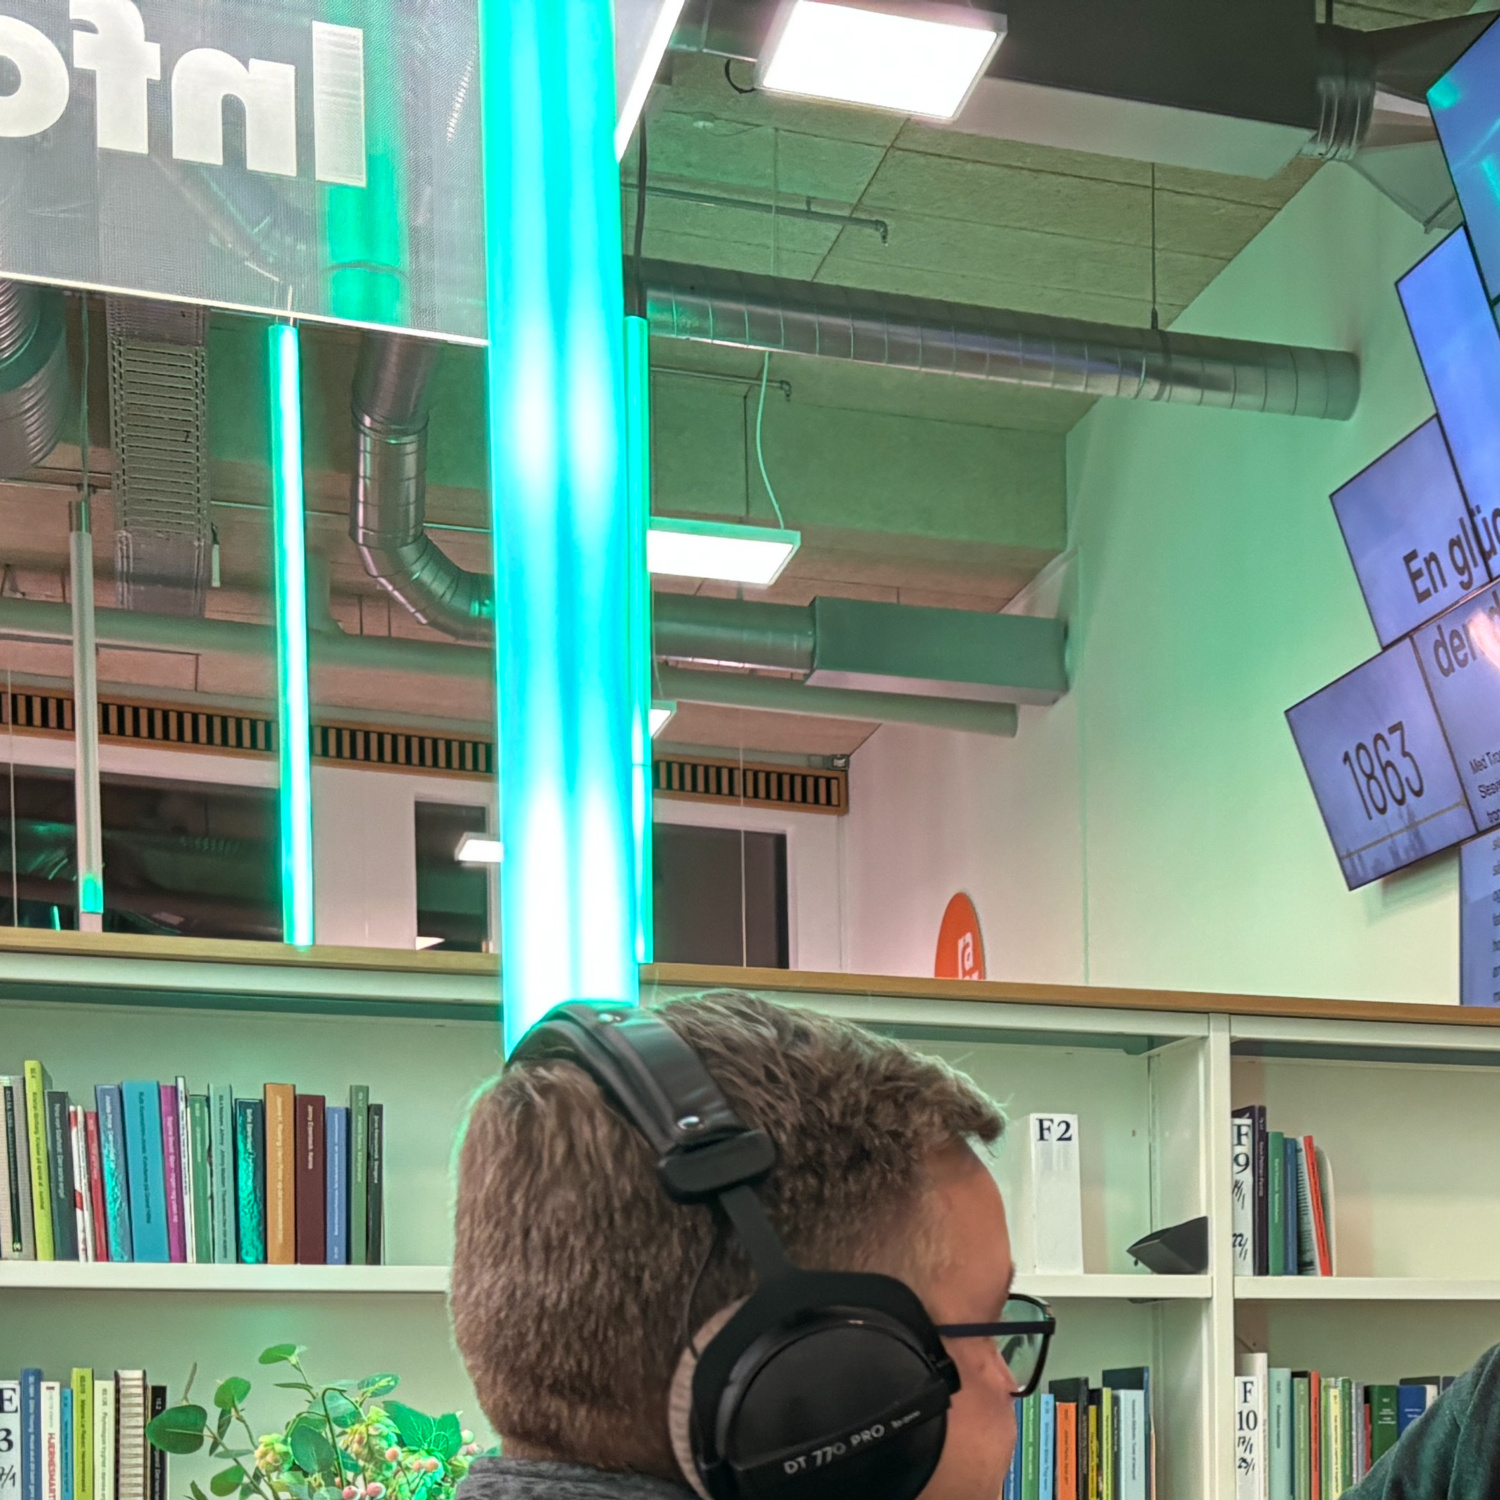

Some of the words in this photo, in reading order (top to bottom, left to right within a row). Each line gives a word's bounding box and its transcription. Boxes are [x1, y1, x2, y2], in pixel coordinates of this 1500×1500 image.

[1403, 549, 1448, 604] En
[1342, 719, 1425, 821] 1863
[1036, 1117, 1073, 1142] F2
[1233, 1124, 1250, 1146] F
[1233, 1153, 1250, 1174] 9
[0, 1388, 18, 1413] E
[1242, 1381, 1254, 1403] F
[1237, 1410, 1258, 1431] 10
[783, 1456, 807, 1474] DT
[811, 1442, 846, 1467] 770
[849, 1424, 885, 1446] PRO
